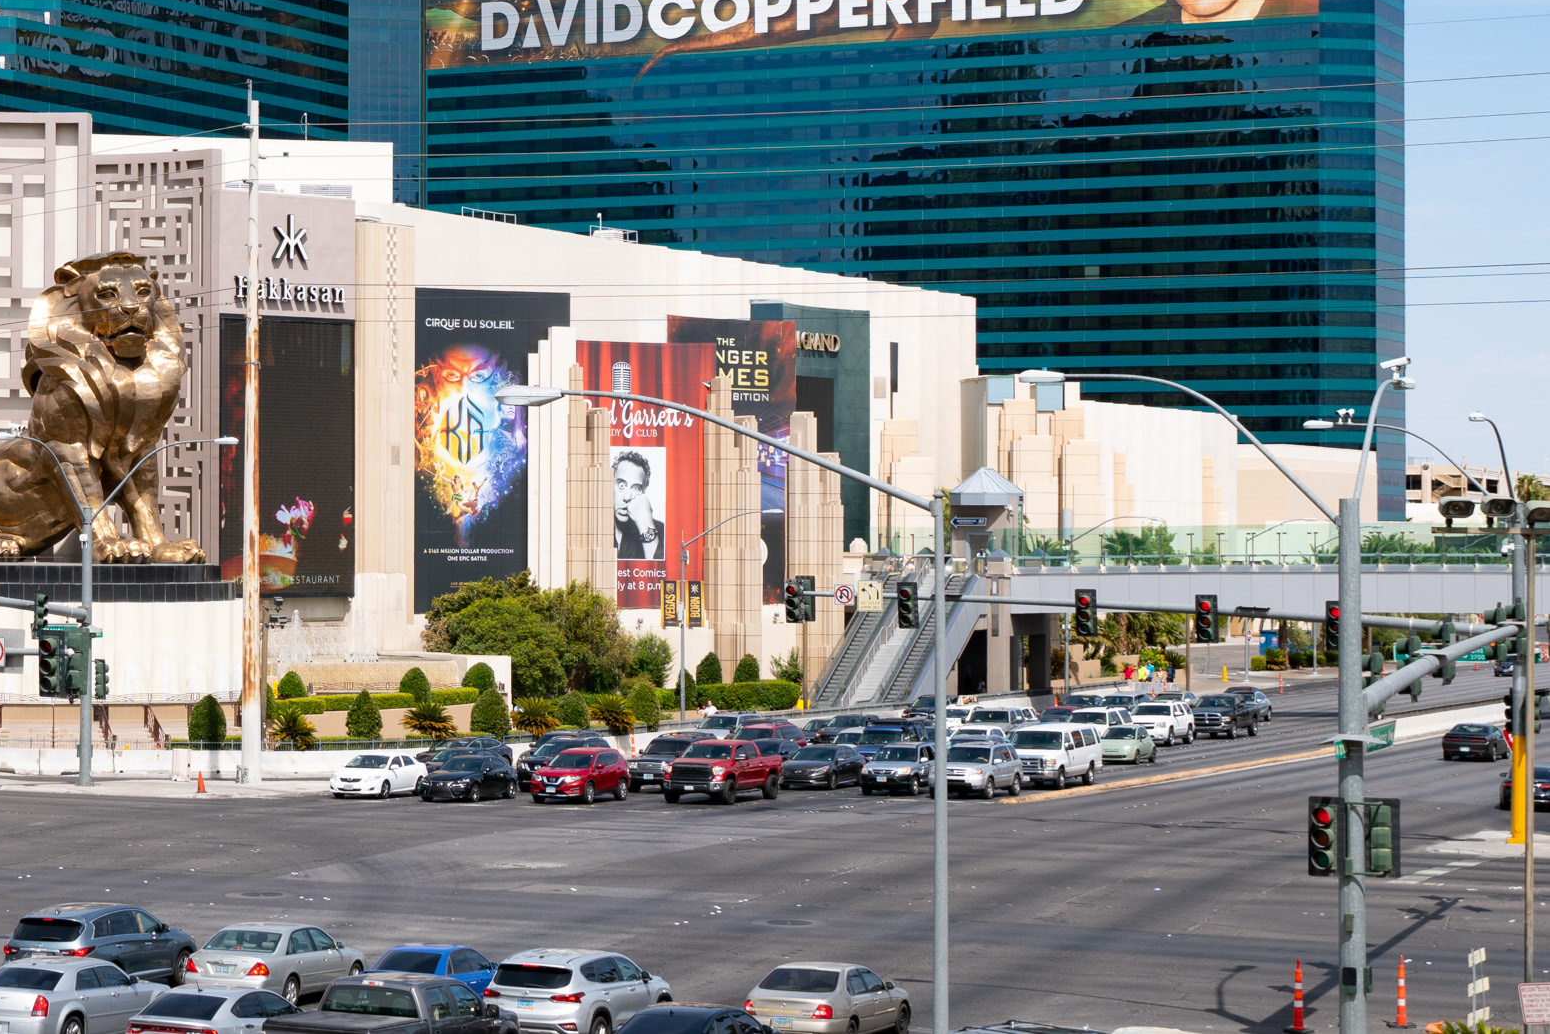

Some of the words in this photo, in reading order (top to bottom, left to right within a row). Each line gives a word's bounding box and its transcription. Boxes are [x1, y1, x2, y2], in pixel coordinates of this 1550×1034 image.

[236, 275, 346, 304] Hakkasan
[425, 318, 460, 330] CIRQUE
[463, 319, 477, 329] DU
[479, 320, 514, 330] SOLEIL
[716, 337, 735, 346] THE
[802, 331, 840, 352] GRAND
[716, 349, 768, 365] NGER
[719, 368, 769, 386] MES
[733, 393, 769, 402] BITION
[636, 428, 658, 437] CLUB
[617, 568, 631, 578] est
[633, 568, 666, 578] Comics
[284, 575, 341, 585] RESTAURANT
[627, 582, 636, 590] at
[638, 581, 645, 590] 8
[665, 594, 676, 619] VEGAS
[690, 596, 701, 618] BORN
